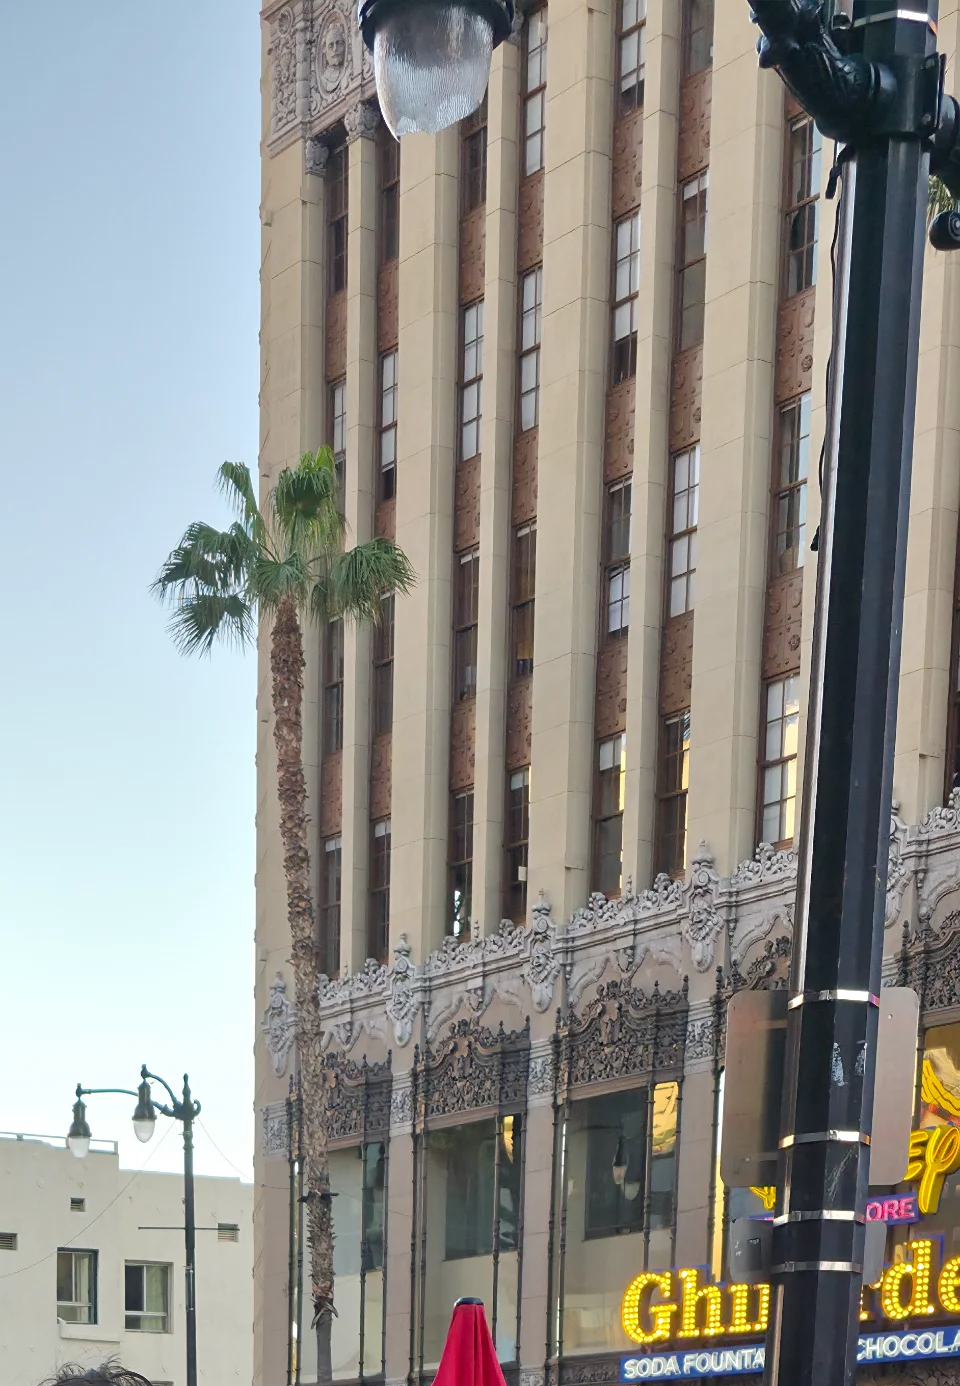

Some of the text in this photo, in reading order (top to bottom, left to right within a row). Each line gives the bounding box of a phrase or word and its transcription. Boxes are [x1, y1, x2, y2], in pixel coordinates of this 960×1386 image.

[865, 1196, 916, 1222] ORE
[624, 1358, 681, 1379] SODA
[683, 1348, 765, 1374] FOUNTA
